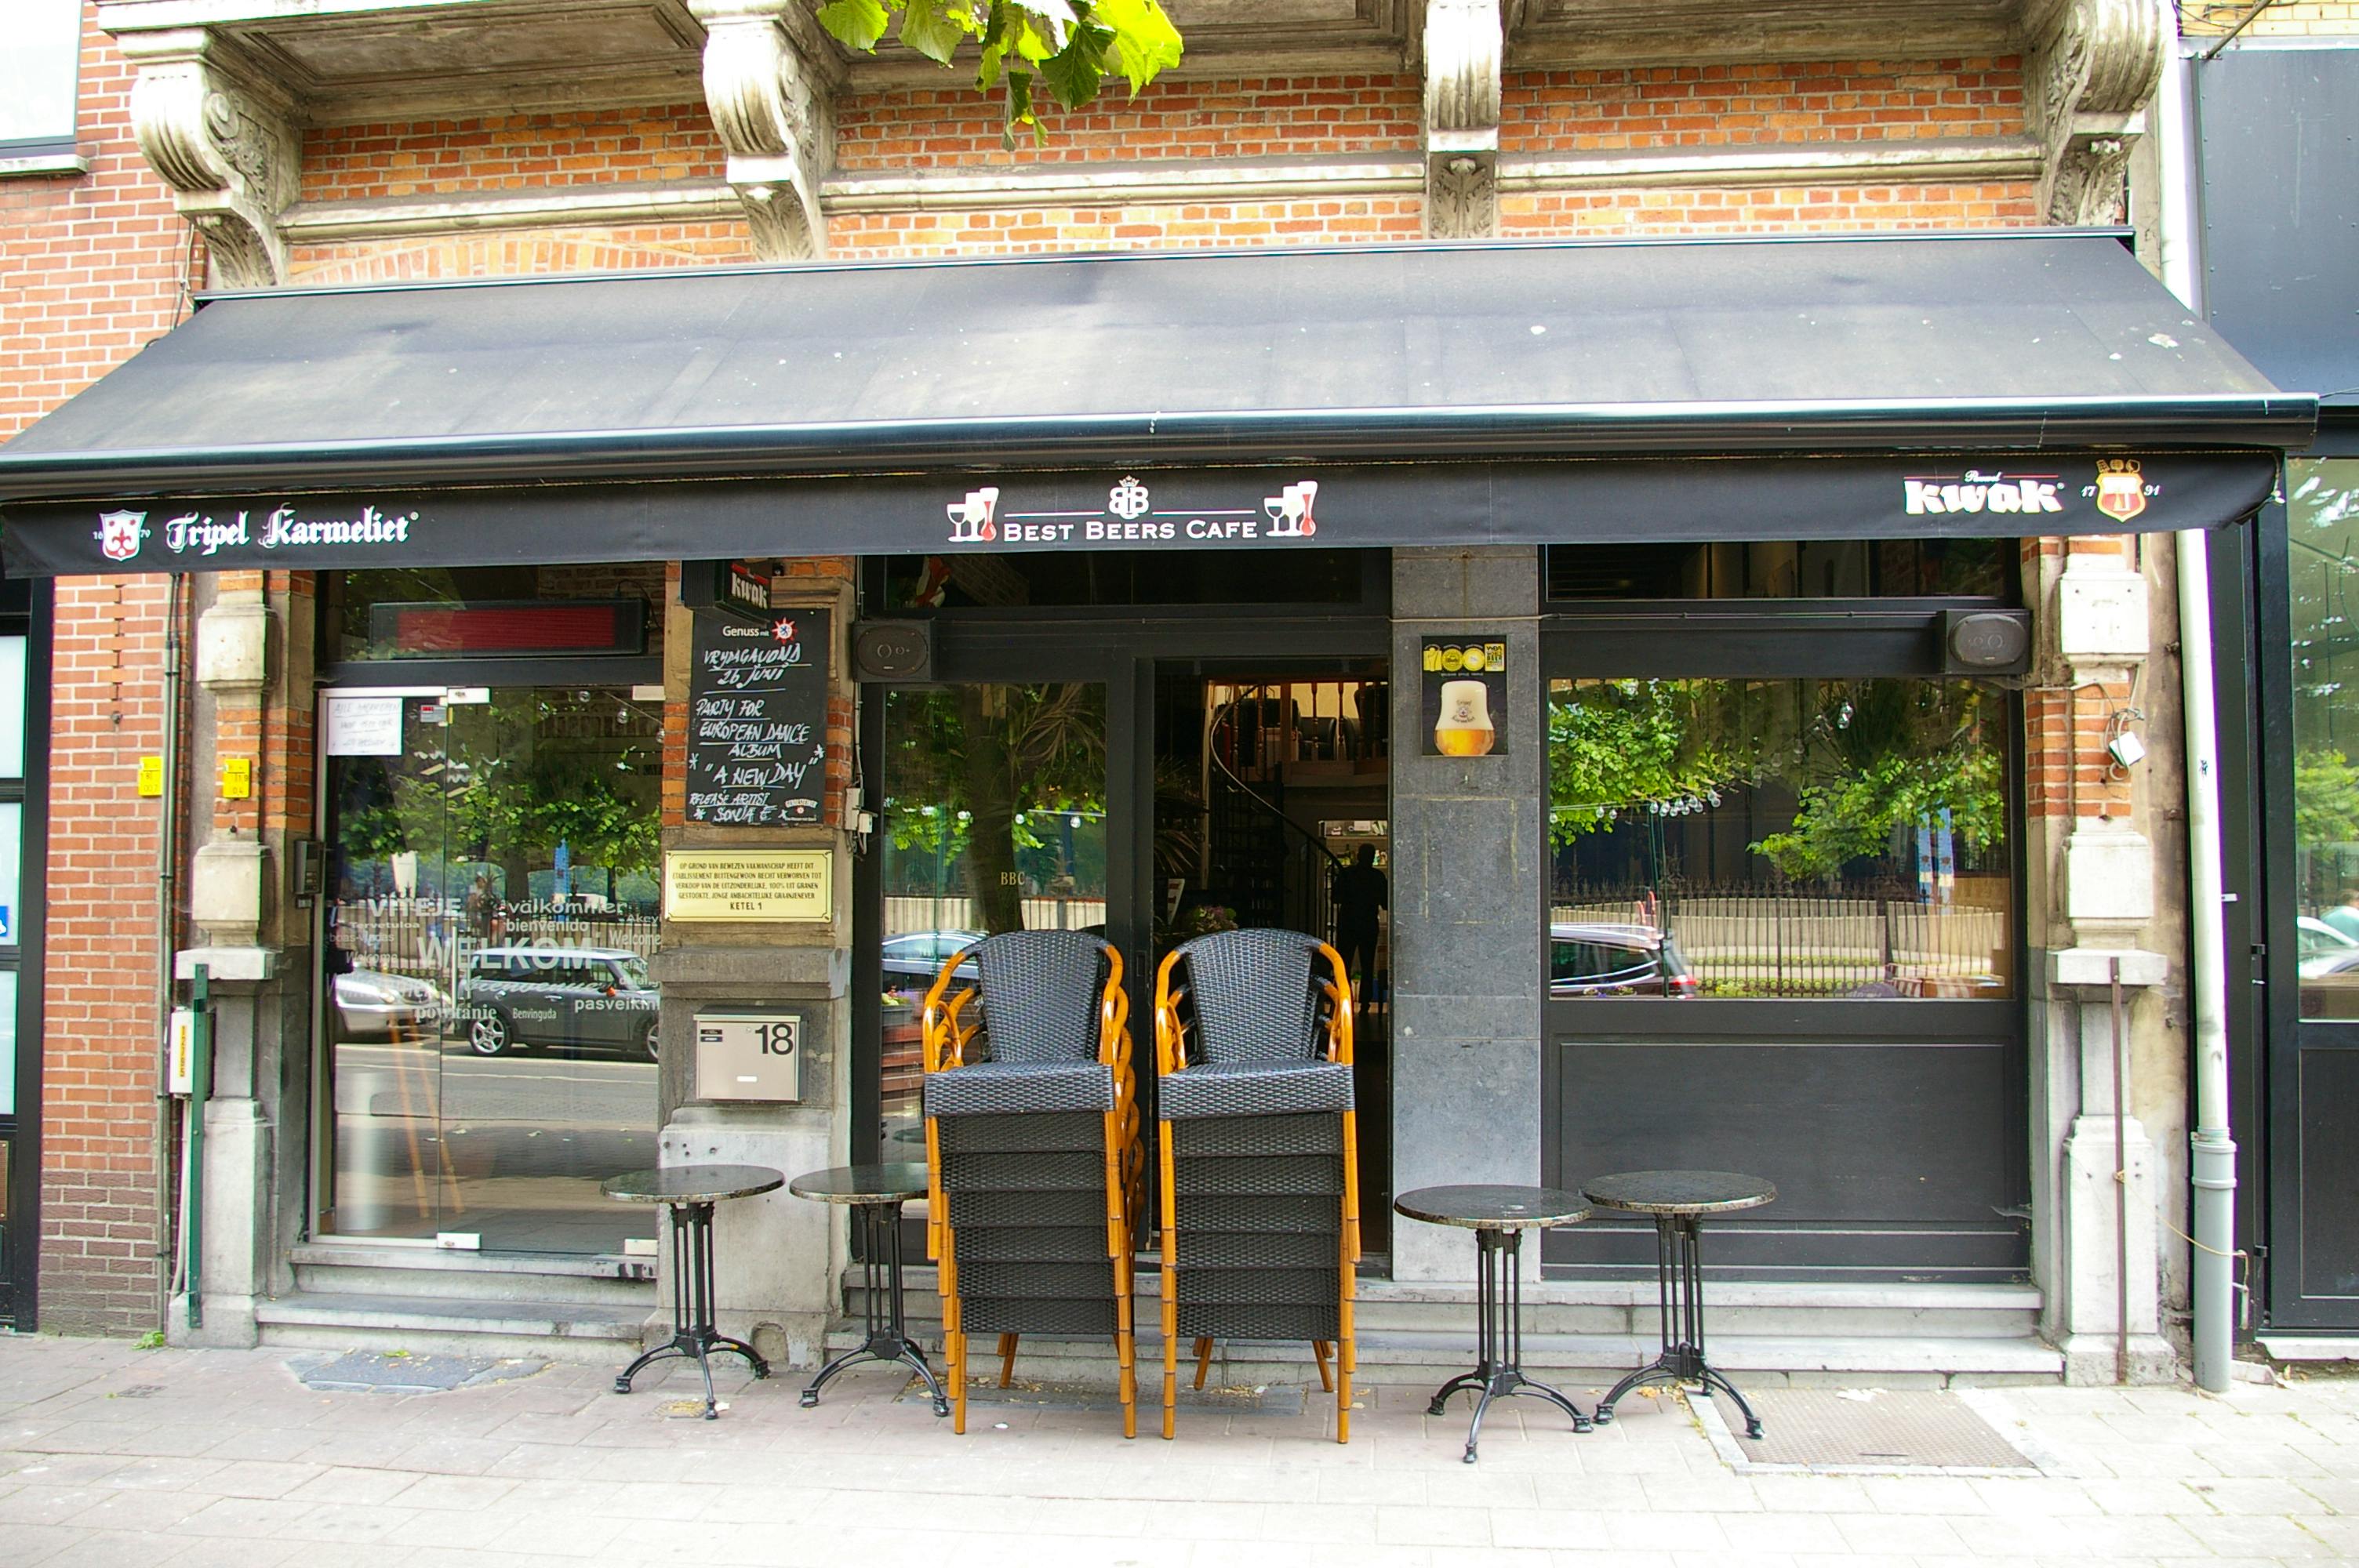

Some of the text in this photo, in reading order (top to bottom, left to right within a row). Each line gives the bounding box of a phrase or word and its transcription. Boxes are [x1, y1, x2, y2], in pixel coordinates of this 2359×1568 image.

[2081, 485, 2160, 498] 17 91
[165, 503, 409, 556] Tripel Karmeliet
[1004, 519, 1257, 542] BEST BEERS CAFE
[722, 626, 760, 637] Genuss
[718, 669, 740, 686] 26
[696, 699, 765, 724] PARTY FOR
[699, 721, 811, 742] EUROPEAN DANCE
[728, 744, 782, 759] ALBUM
[732, 766, 770, 786] NEW
[689, 791, 730, 805] RELEASE
[732, 792, 771, 805] ARTIST
[1001, 871, 1025, 885] BBC
[506, 918, 588, 933] bienvenido
[609, 929, 661, 946] Welcome
[346, 951, 398, 964] Welcome
[416, 937, 592, 970] WELKOM
[513, 1007, 557, 1022] Benvinguda
[754, 1023, 794, 1055] 18
